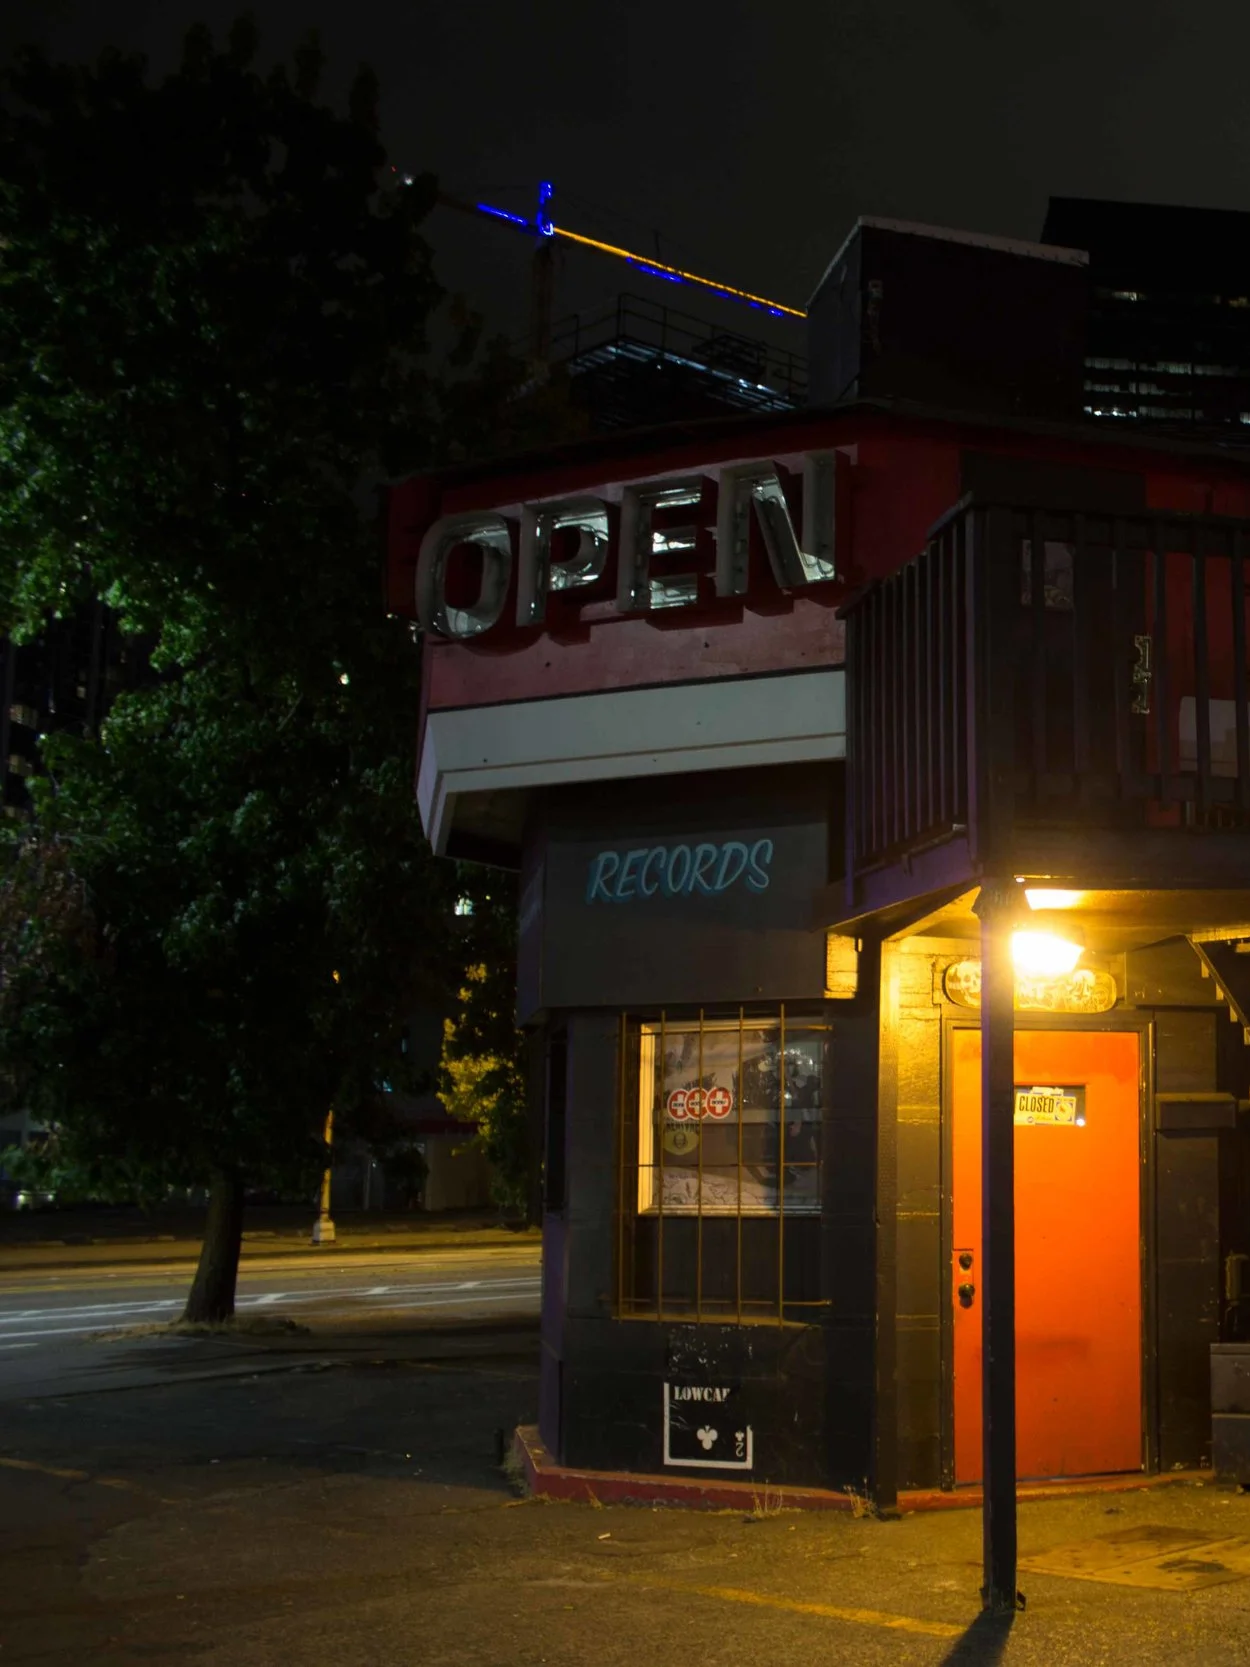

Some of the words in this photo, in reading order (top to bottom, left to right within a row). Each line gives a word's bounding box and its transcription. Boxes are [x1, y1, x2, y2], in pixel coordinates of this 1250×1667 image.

[415, 448, 838, 640] OPEN
[585, 838, 774, 904] RECORDS
[1019, 1095, 1054, 1113] CLOSED
